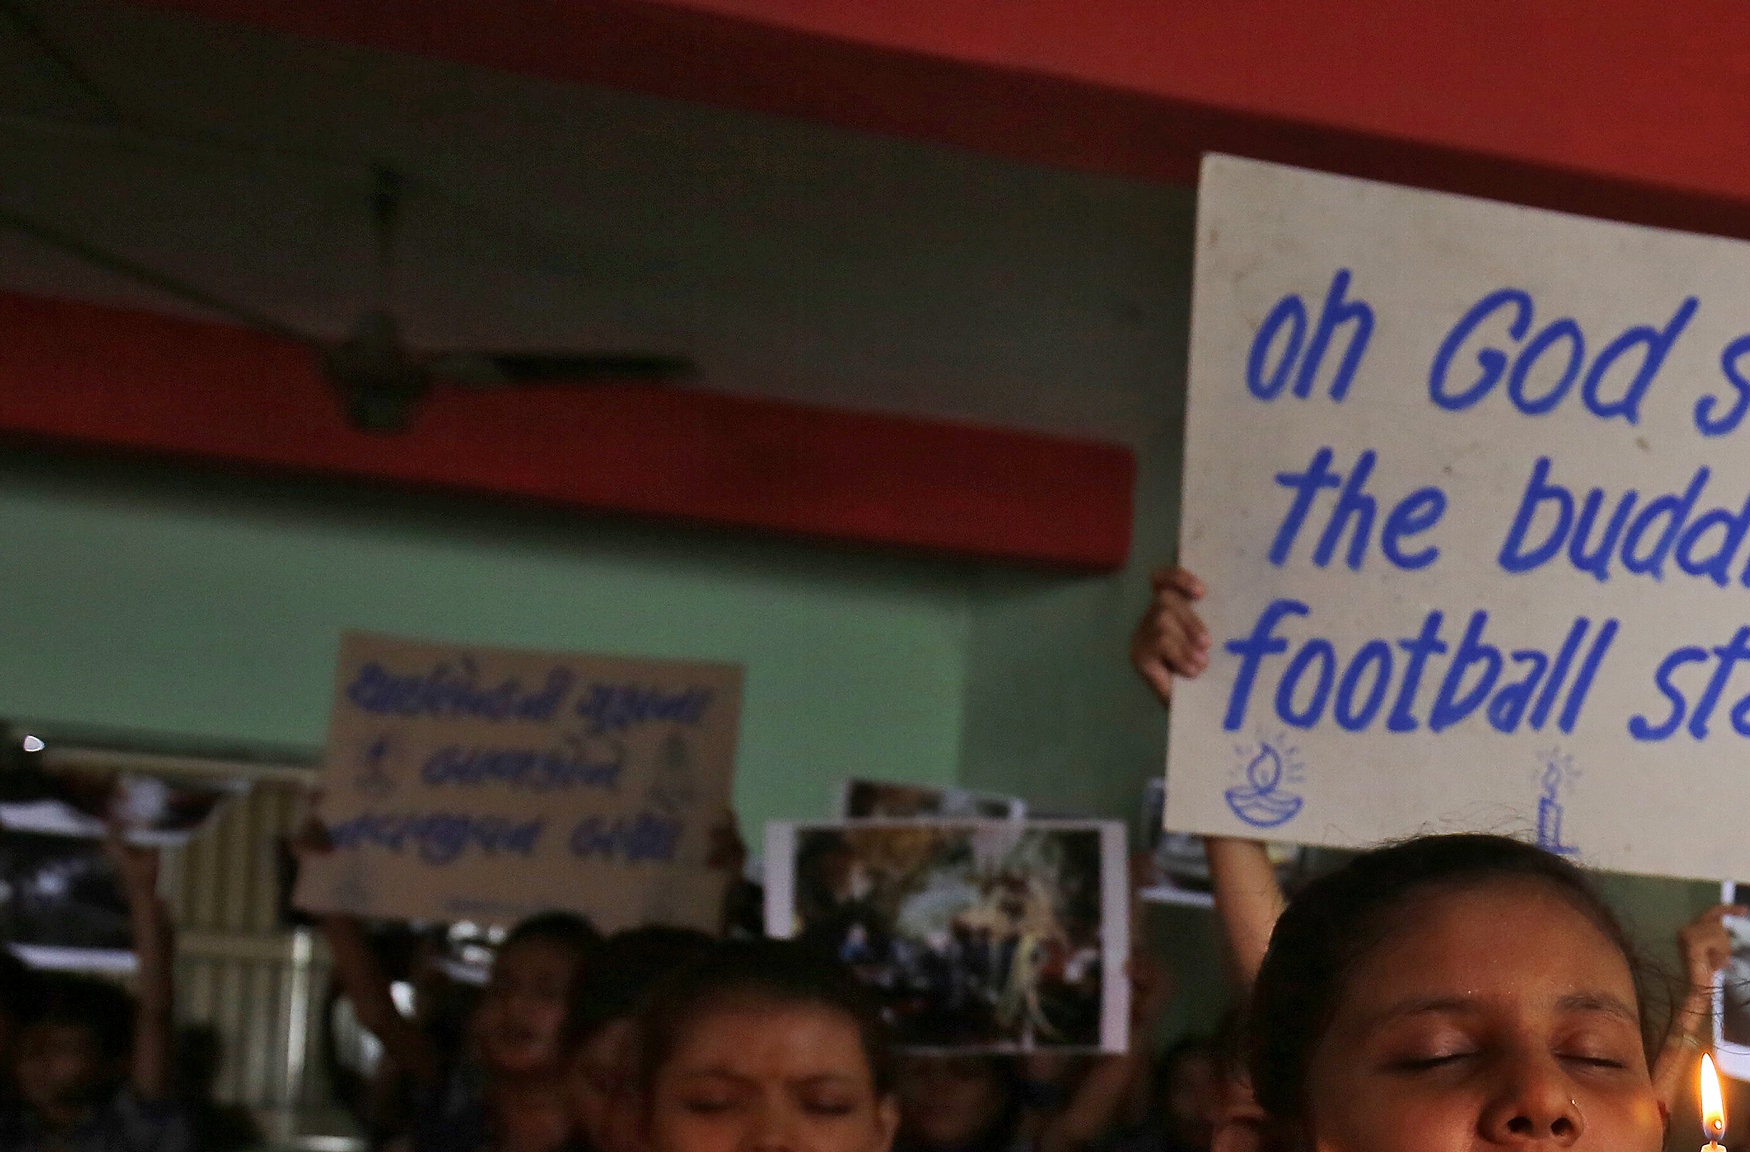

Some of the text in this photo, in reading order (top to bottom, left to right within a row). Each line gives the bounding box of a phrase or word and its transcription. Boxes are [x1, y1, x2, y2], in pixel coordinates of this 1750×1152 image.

[1247, 270, 1374, 400] oh
[1429, 290, 1698, 424] God
[1269, 449, 1446, 570] the
[1224, 600, 1619, 734] football
